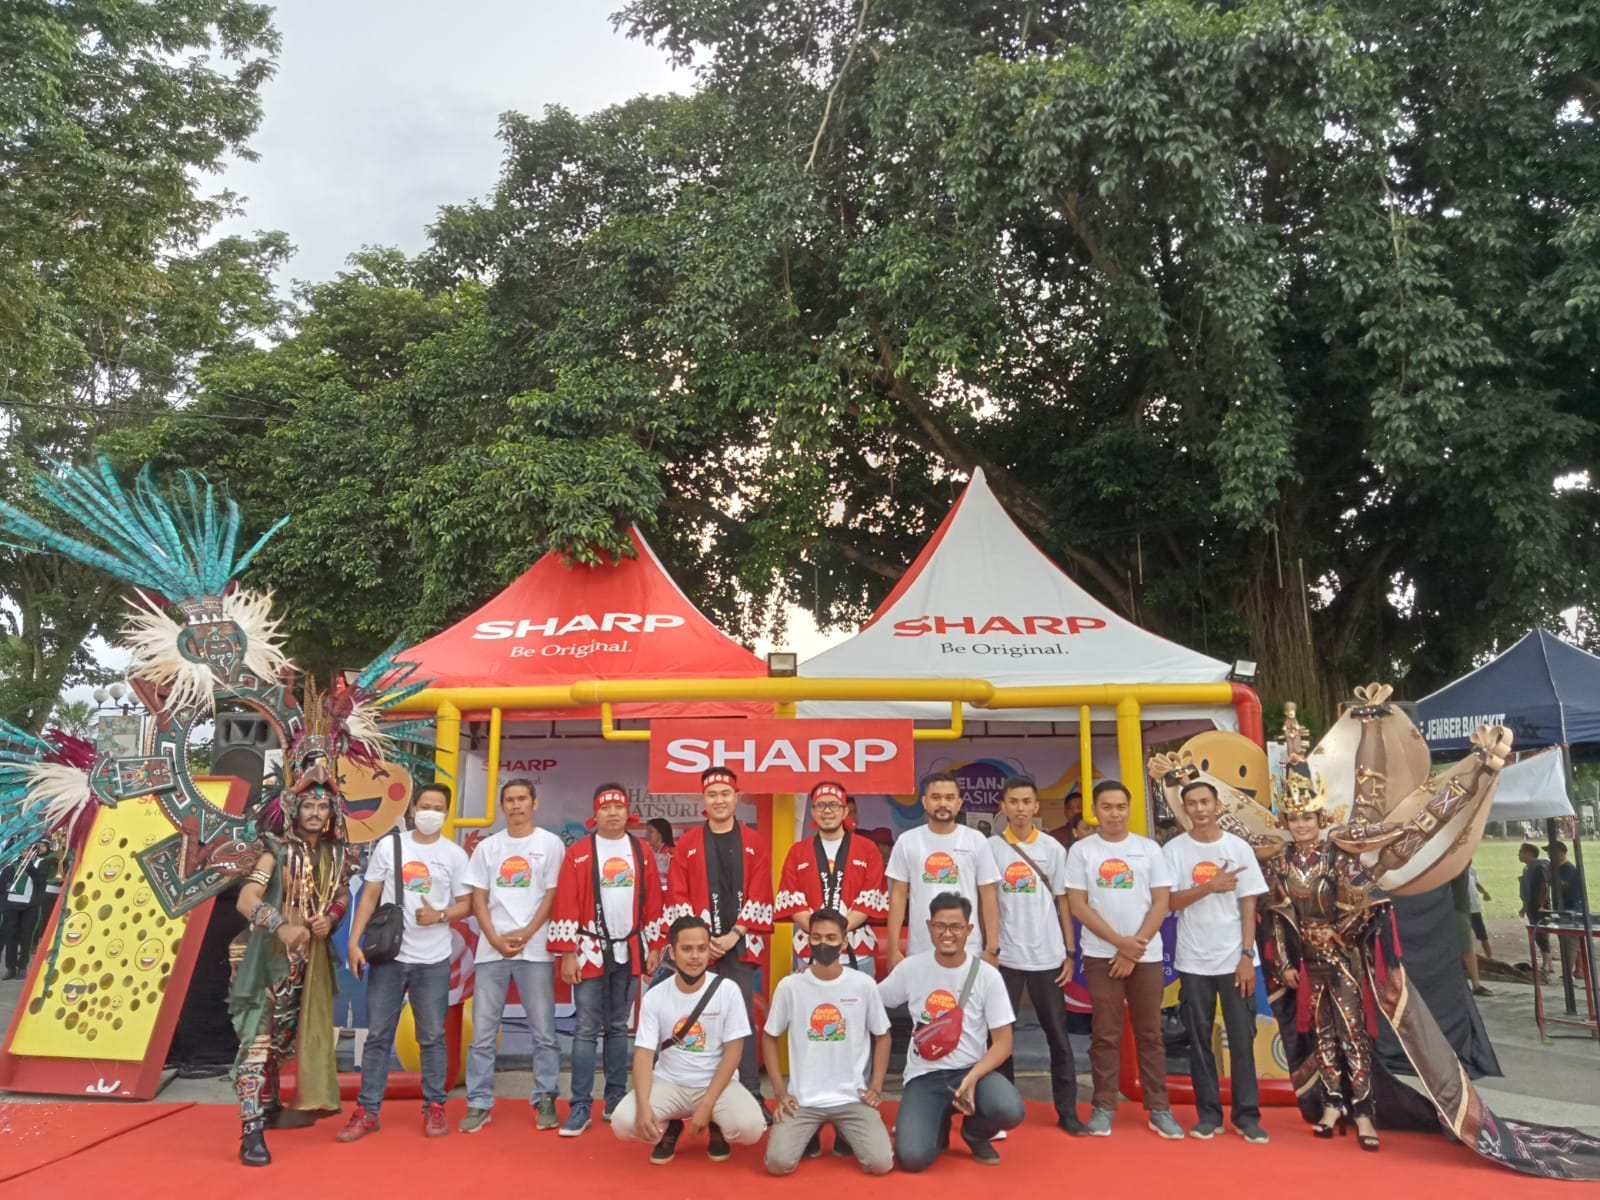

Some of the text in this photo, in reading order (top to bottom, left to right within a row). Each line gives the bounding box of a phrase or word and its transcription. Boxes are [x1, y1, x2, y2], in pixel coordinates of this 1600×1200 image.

[472, 613, 685, 640] SHARP
[893, 616, 1107, 637] SHARP
[509, 639, 632, 659] Be Original.
[941, 643, 1069, 658] Be Original.
[1426, 719, 1460, 741] JEMBER
[665, 738, 897, 773] SHARP
[963, 791, 1000, 804] ASIK
